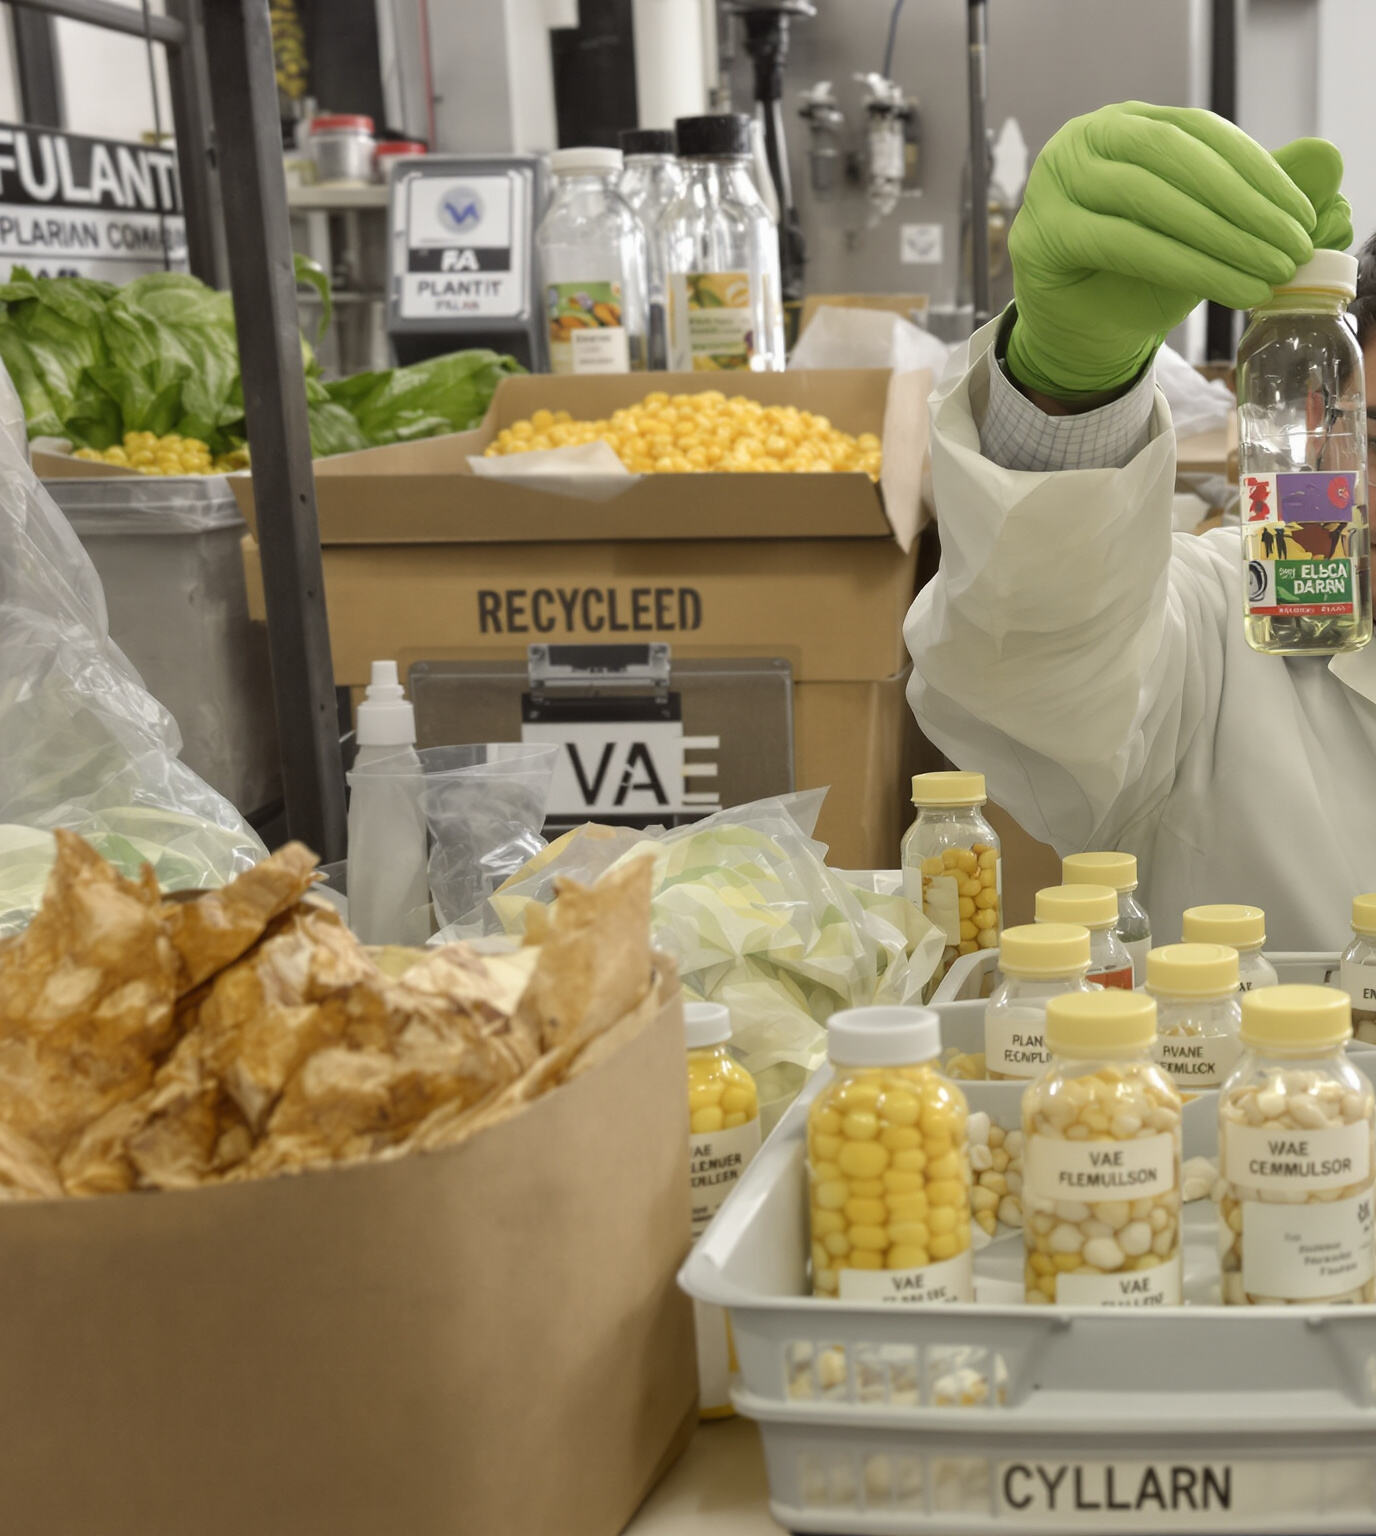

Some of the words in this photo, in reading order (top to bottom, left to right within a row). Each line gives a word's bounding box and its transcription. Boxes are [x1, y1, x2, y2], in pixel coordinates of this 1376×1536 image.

[477, 588, 703, 634] RECYCLEED
[1089, 1150, 1124, 1167] VAE
[892, 1274, 925, 1291] VAE
[1120, 1278, 1151, 1295] VAE
[1002, 1462, 1233, 1511] CYLLARN
